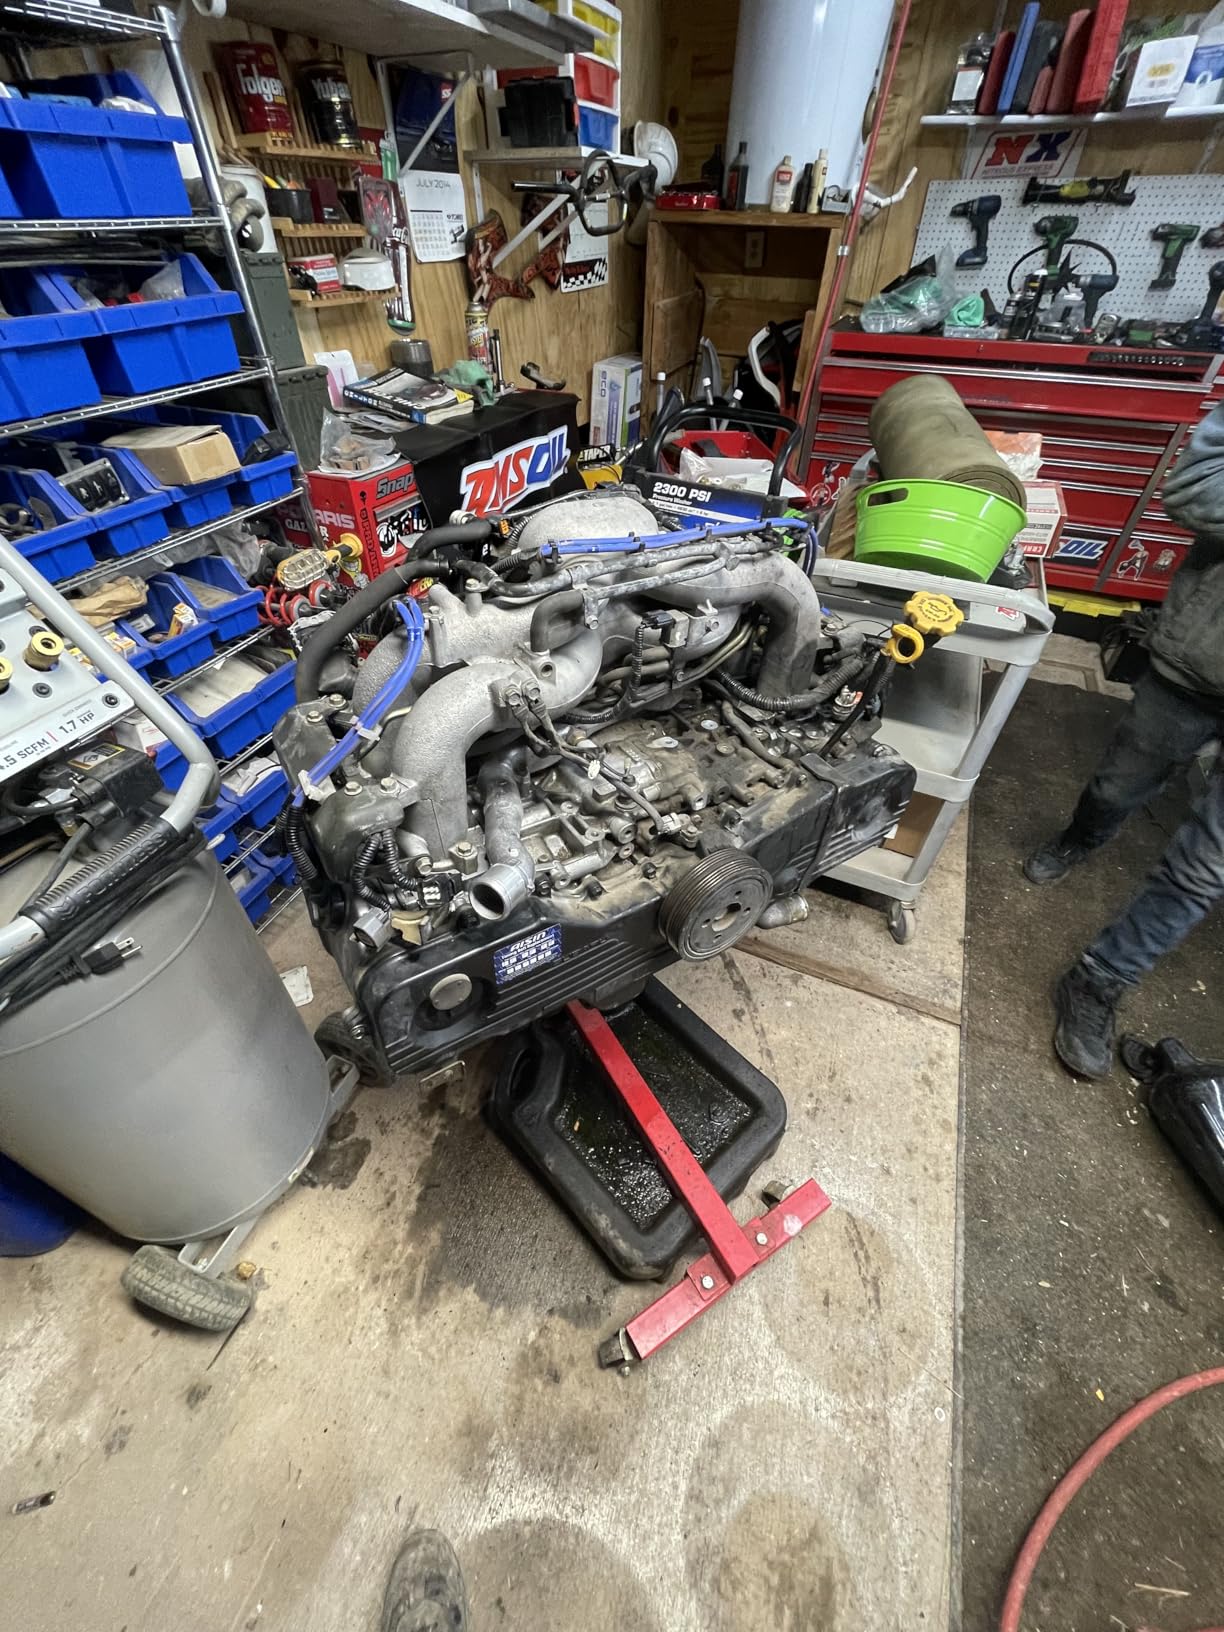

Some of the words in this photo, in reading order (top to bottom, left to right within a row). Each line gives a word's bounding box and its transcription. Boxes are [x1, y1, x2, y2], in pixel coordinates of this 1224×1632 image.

[236, 63, 287, 103] Folger
[311, 77, 352, 101] Yuba
[985, 131, 1073, 166] NX
[416, 178, 435, 189] JULY
[376, 472, 415, 499] Snap
[463, 429, 570, 518] AMSOIL
[653, 482, 687, 498] 2300
[689, 488, 712, 502] PSI
[277, 503, 355, 530] POARIS
[1058, 539, 1107, 559] OIL
[58, 719, 77, 734] 1.7
[80, 712, 95, 724] HP
[17, 738, 49, 758] SCFM
